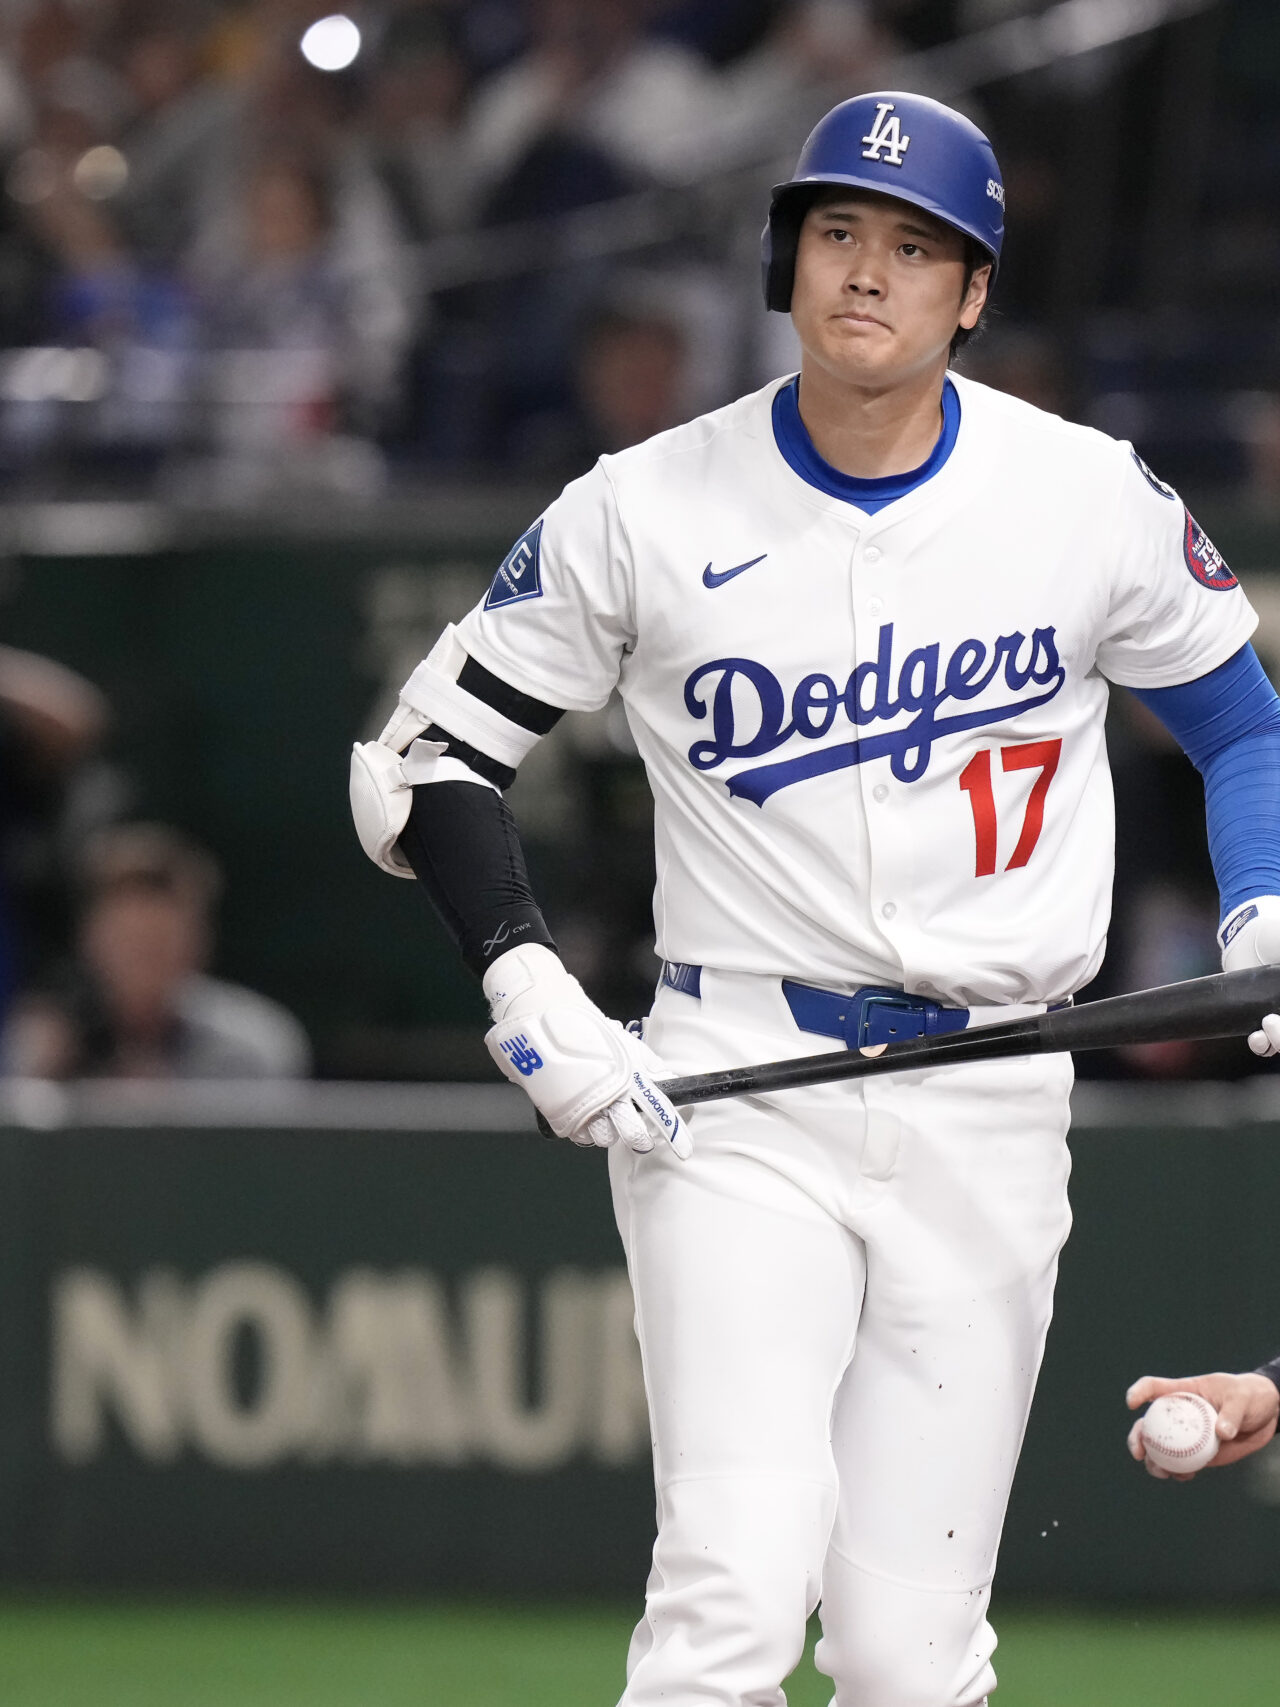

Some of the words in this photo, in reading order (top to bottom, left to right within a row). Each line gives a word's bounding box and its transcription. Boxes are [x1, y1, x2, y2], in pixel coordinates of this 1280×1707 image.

[861, 102, 910, 166] LA
[684, 622, 1065, 795] Dodgers
[958, 737, 1062, 878] 17
[632, 1072, 645, 1092] new
[642, 1088, 672, 1127] balance
